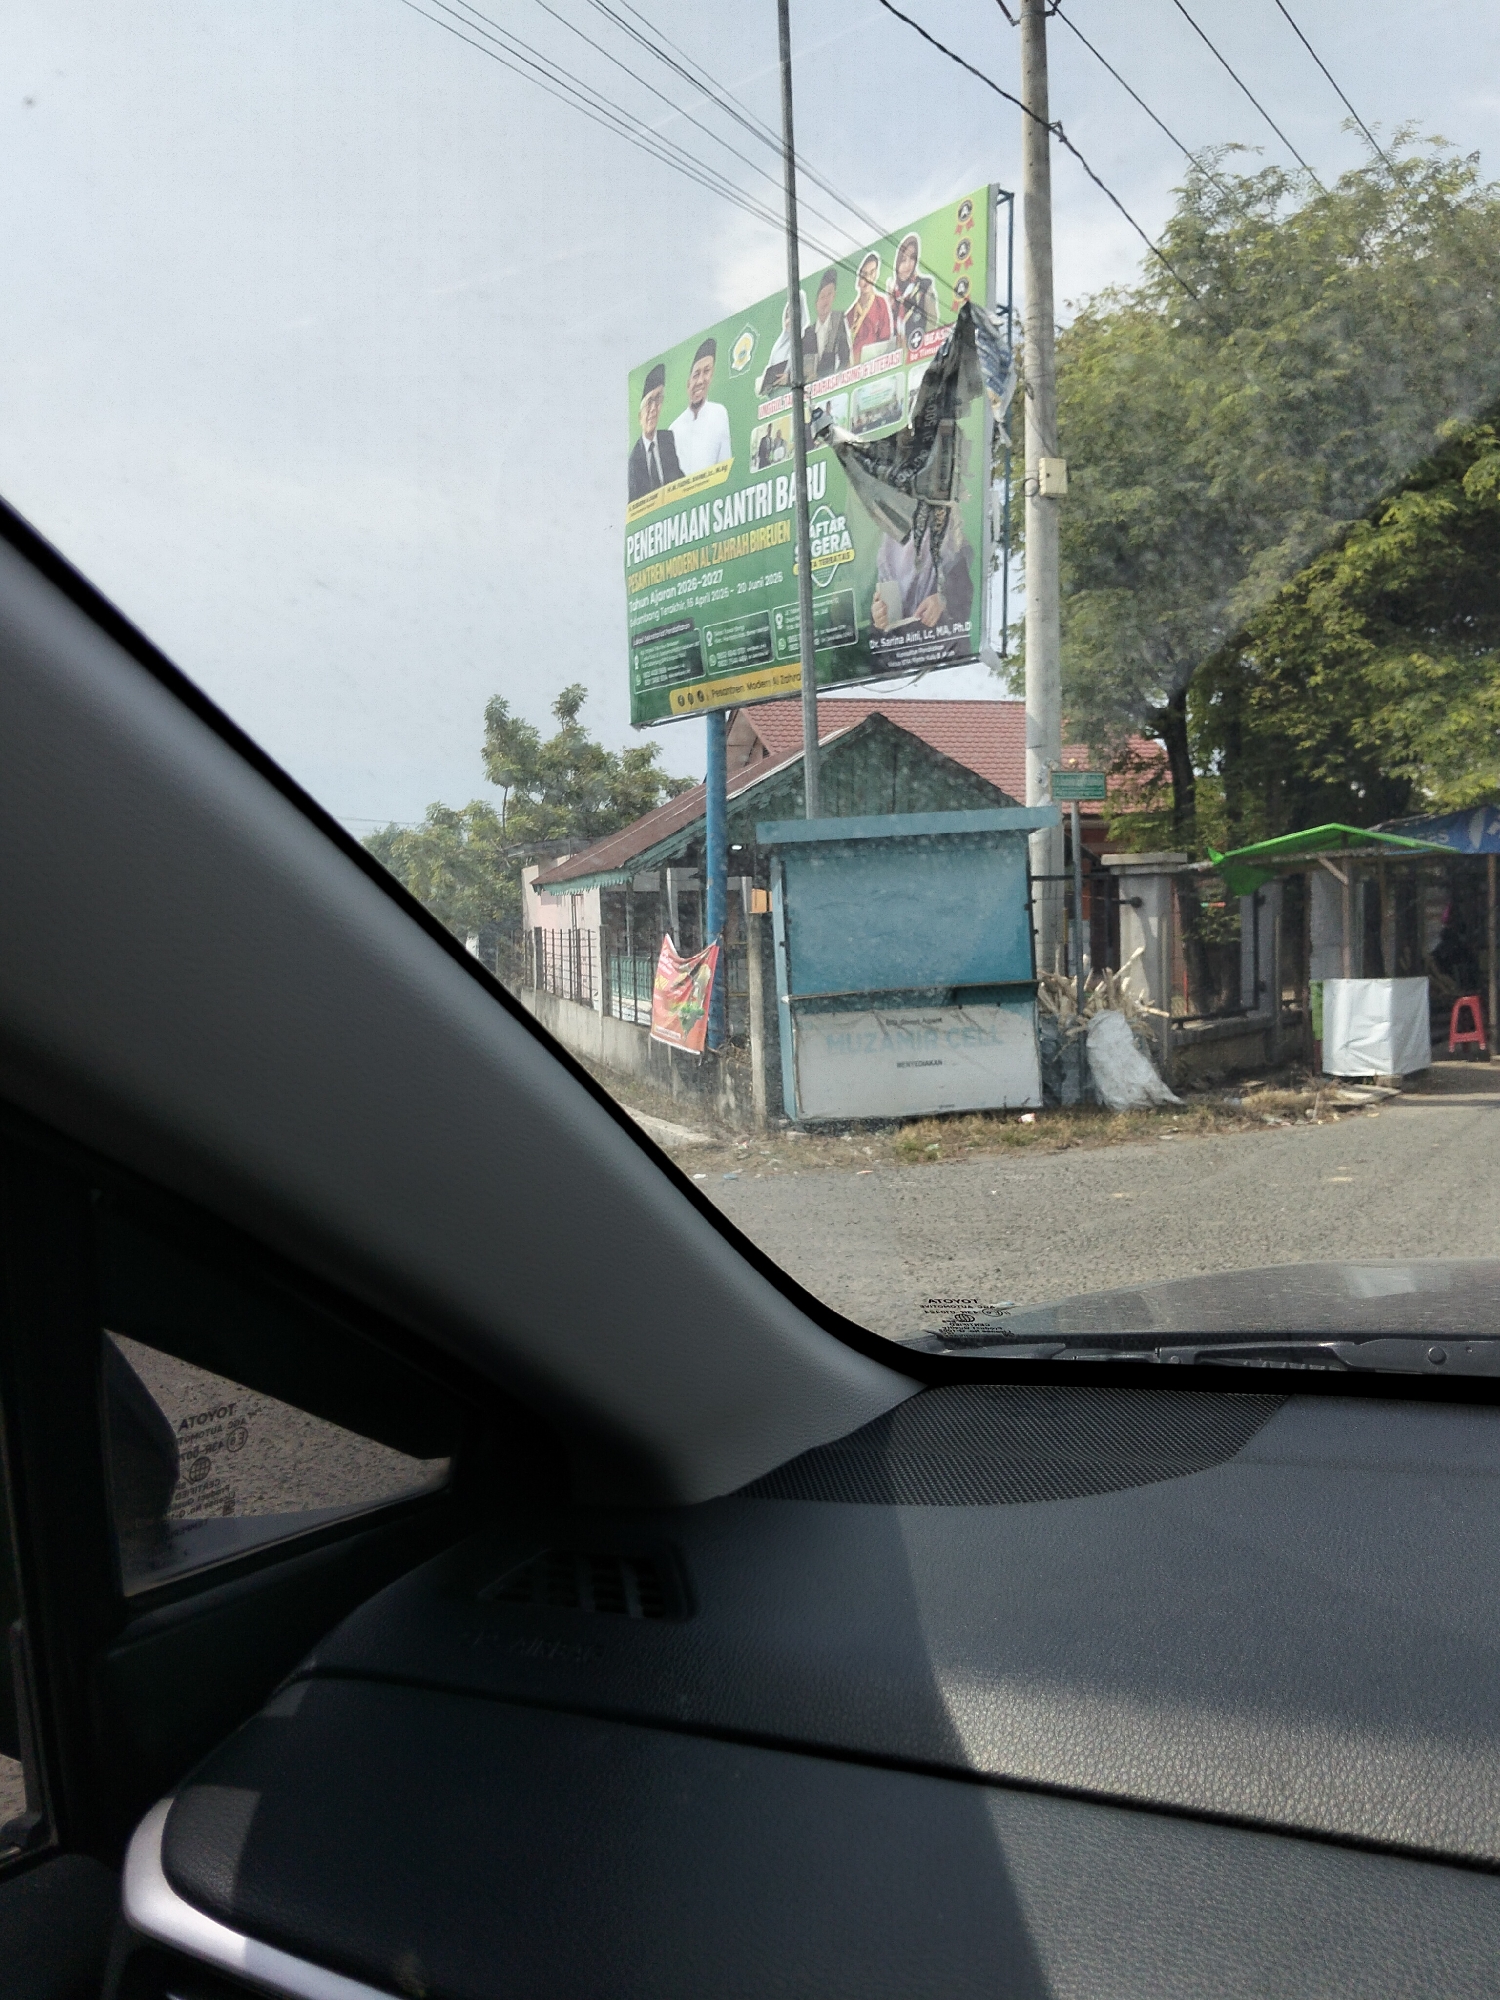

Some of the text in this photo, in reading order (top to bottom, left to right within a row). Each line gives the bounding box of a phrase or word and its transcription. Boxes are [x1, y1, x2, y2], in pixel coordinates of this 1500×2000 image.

[626, 461, 826, 568] PENERIMAAN SANTRI BARU
[809, 516, 846, 538] AFTAR
[628, 519, 790, 595] PESANTREN MODERN AL ZAHRAH BIREUEN
[629, 569, 723, 613] Tahun Ajaran 2026-2027
[695, 592, 710, 607] April
[737, 582, 747, 594] 20
[748, 576, 764, 591] Juni
[711, 685, 743, 698] Pesantren
[747, 679, 771, 690] Modern
[780, 673, 801, 685] Zahra
[945, 1024, 1004, 1049] CELL
[897, 1060, 942, 1068] MENYEDIAKAN
